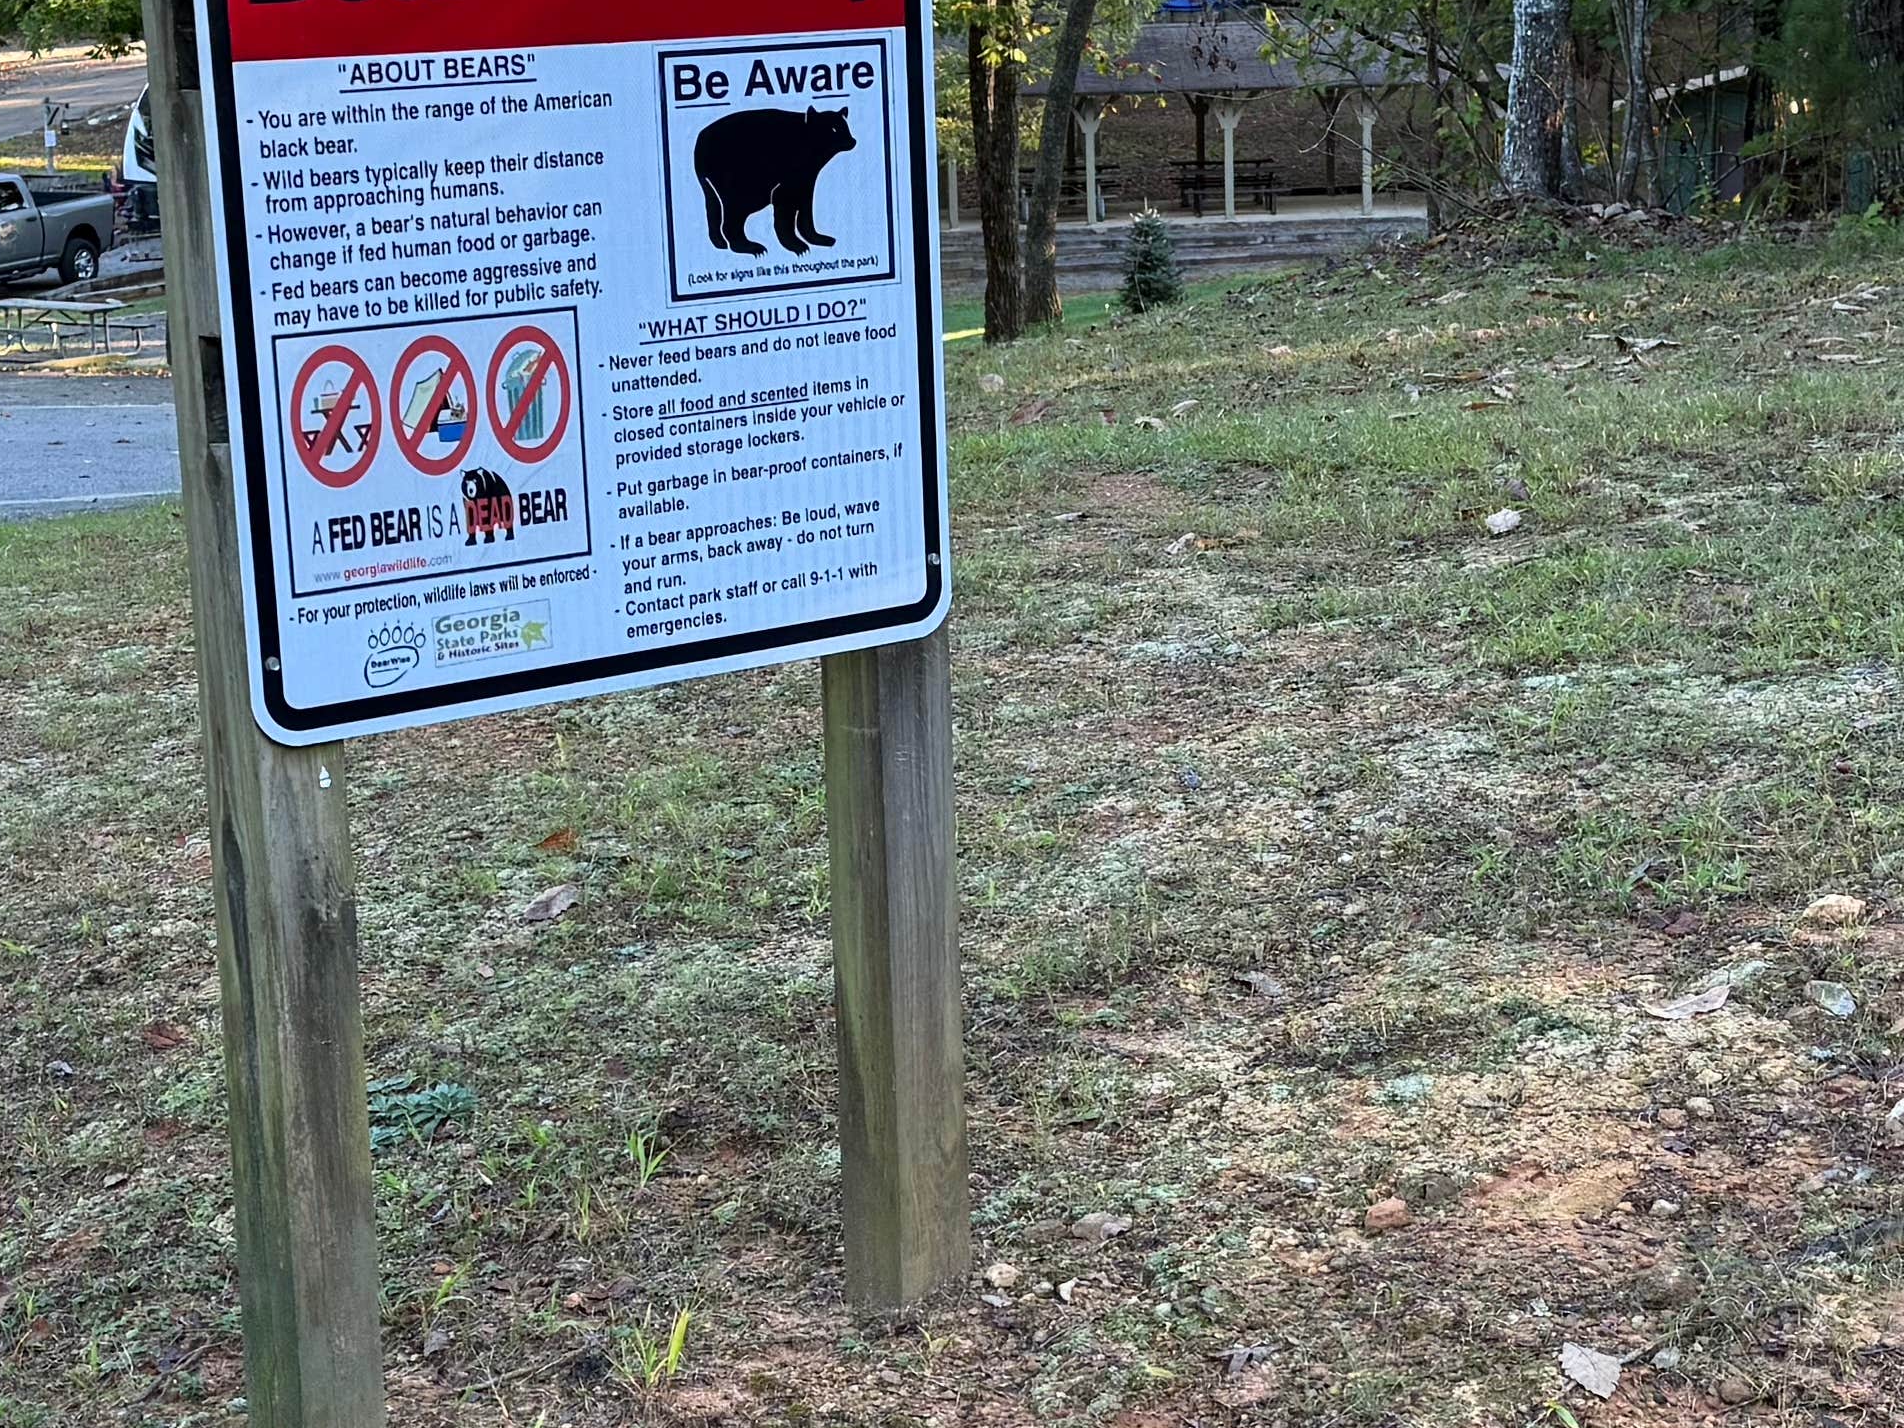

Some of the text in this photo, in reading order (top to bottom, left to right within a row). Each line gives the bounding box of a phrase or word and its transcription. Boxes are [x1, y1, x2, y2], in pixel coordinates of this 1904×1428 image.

[337, 53, 536, 85] "ABOUT BEARS"
[672, 58, 875, 101] Be Aware
[257, 89, 613, 129] You are within the range of the American
[259, 135, 358, 158] black bear.
[262, 150, 605, 190] Wild bears typically keep their distance
[265, 181, 505, 214] from approaching humans.
[267, 201, 603, 244] However, a bear's natural behavior can
[269, 226, 596, 271] change if fed human food or garbage.
[271, 251, 597, 301] Fed bears can become aggressive and
[273, 277, 603, 328] may have to be killed for public safety.
[638, 297, 867, 338] "WHAT SHOULD I DO?"
[608, 322, 897, 371] Never feed bears and do not leave food
[611, 368, 702, 392] unattended.
[612, 375, 869, 420] Store all food and scented items in
[613, 394, 906, 443] closed containers inside your vehicle or
[615, 429, 805, 469] provided storage lockers.
[616, 441, 903, 497] Put garbage in bear-proof containers, if
[311, 487, 569, 556] A FED BEAR IS A DEAD BEAR
[618, 496, 690, 519] available.
[620, 499, 880, 550] If a bear approaches: Be loud, wave
[314, 554, 452, 583] www.georgiawildlife.com
[621, 522, 875, 576] your arms, back away do not turn
[297, 563, 590, 625] For your protection, wildlife laws will be enforced
[623, 574, 687, 594] and run.
[625, 561, 878, 616] Contact park staff or call 9-1-1 with
[435, 608, 520, 634] Georgia
[436, 627, 518, 651] State Parks
[626, 610, 727, 638] emergencies.
